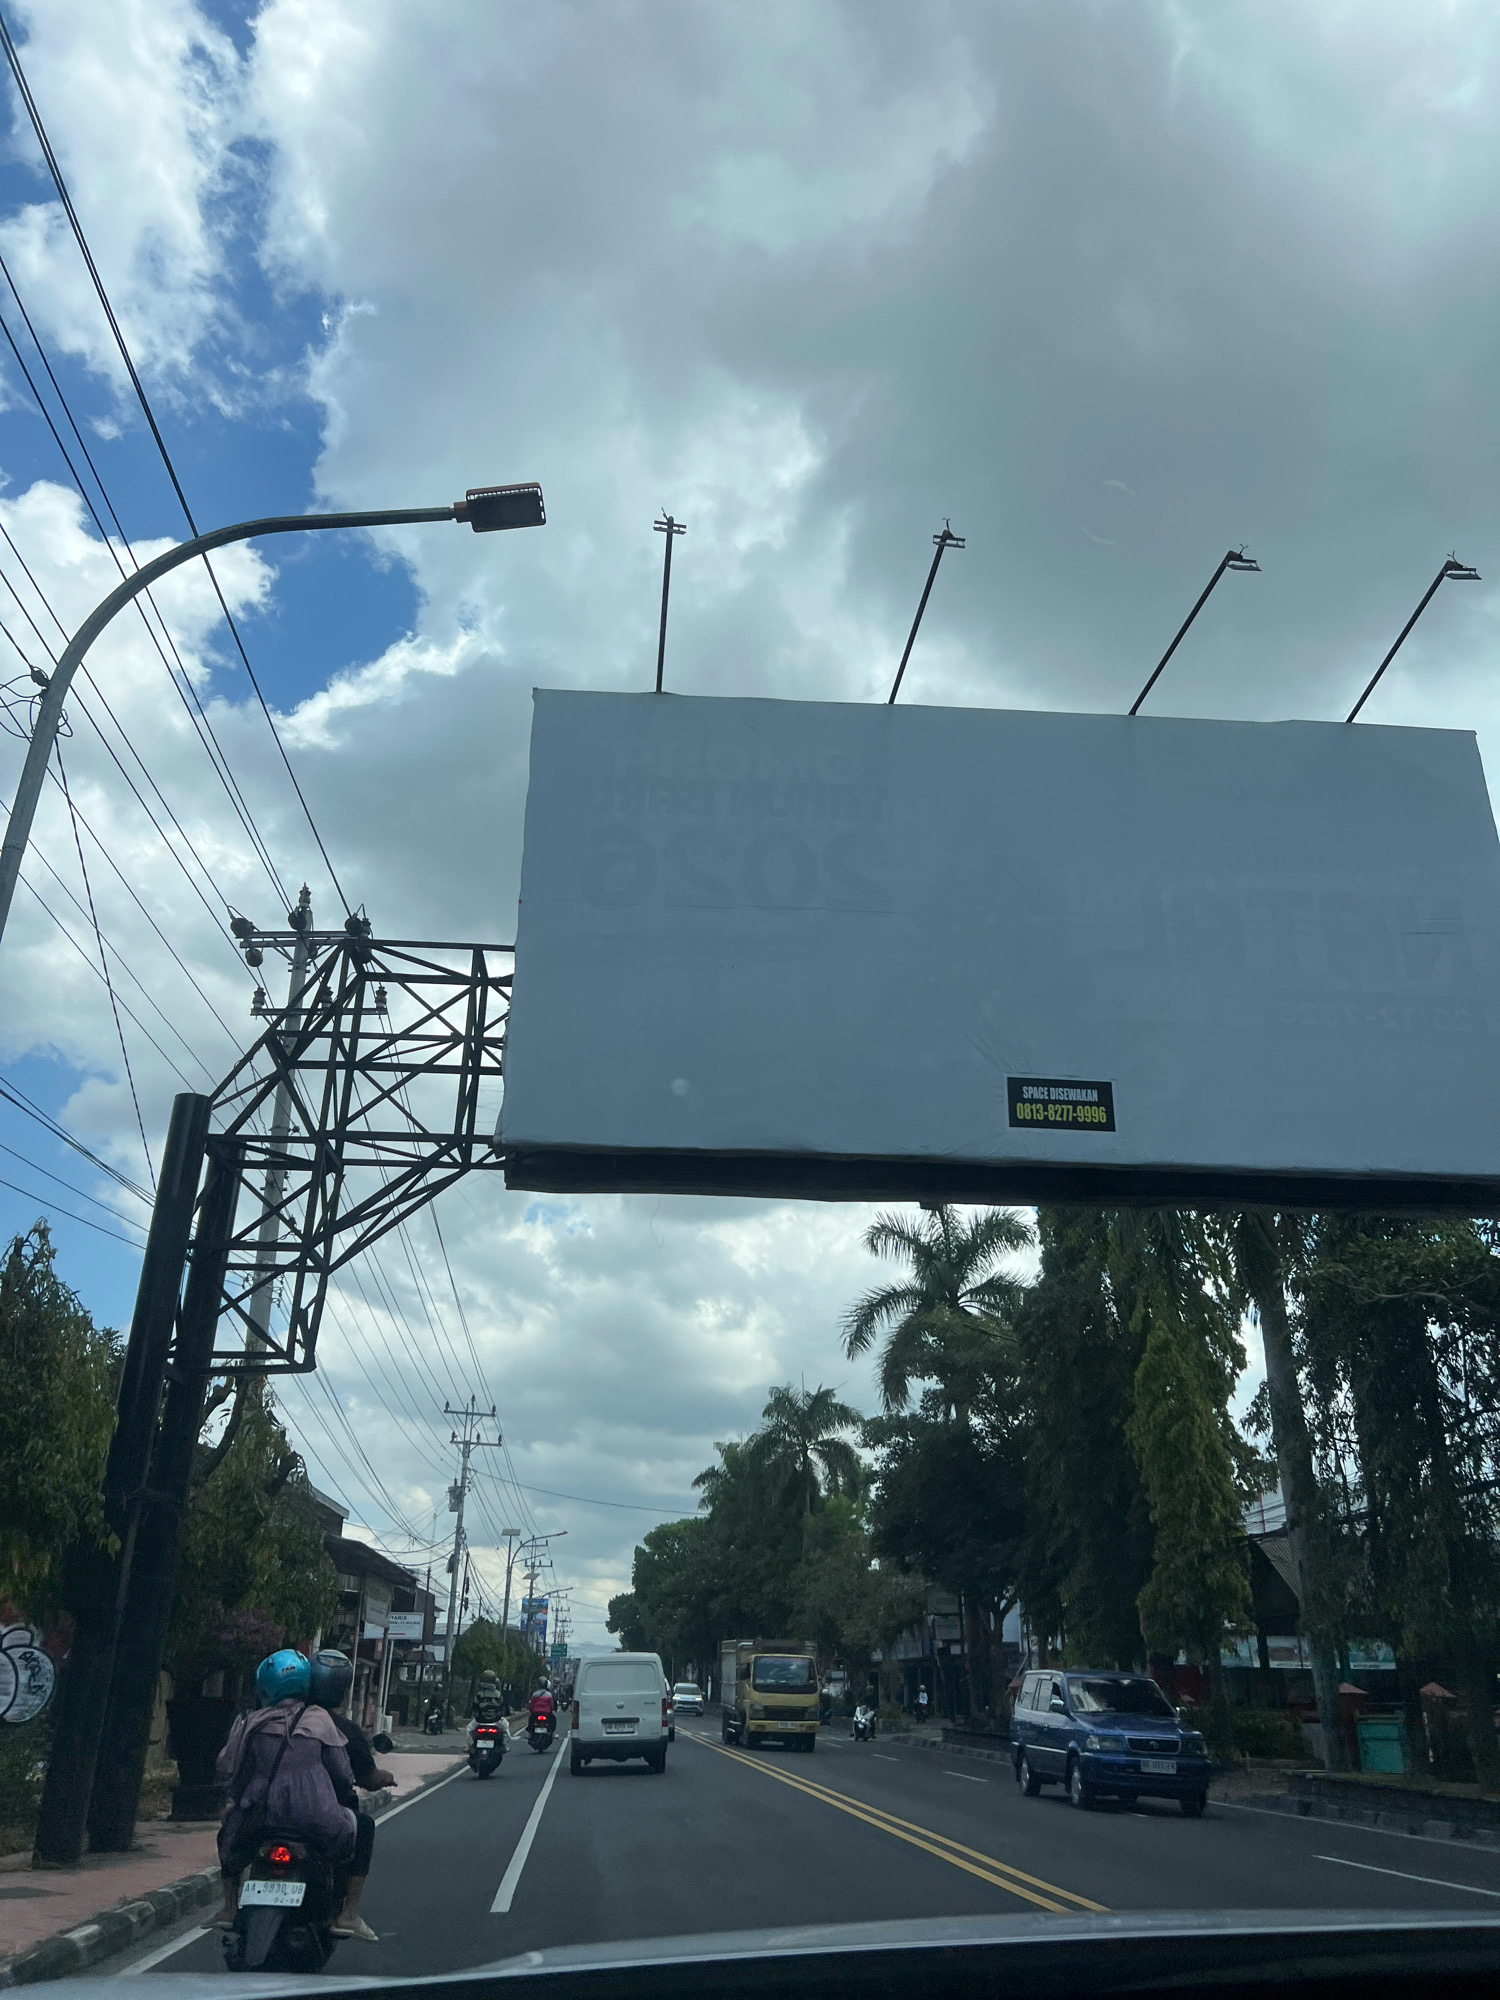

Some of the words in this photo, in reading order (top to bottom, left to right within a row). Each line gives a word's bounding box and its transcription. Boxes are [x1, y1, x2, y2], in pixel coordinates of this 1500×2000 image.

[1022, 1086, 1049, 1099] SPACE
[1049, 1087, 1098, 1102] DISEWAKAN
[1016, 1102, 1107, 1123] 0813-8277-9996
